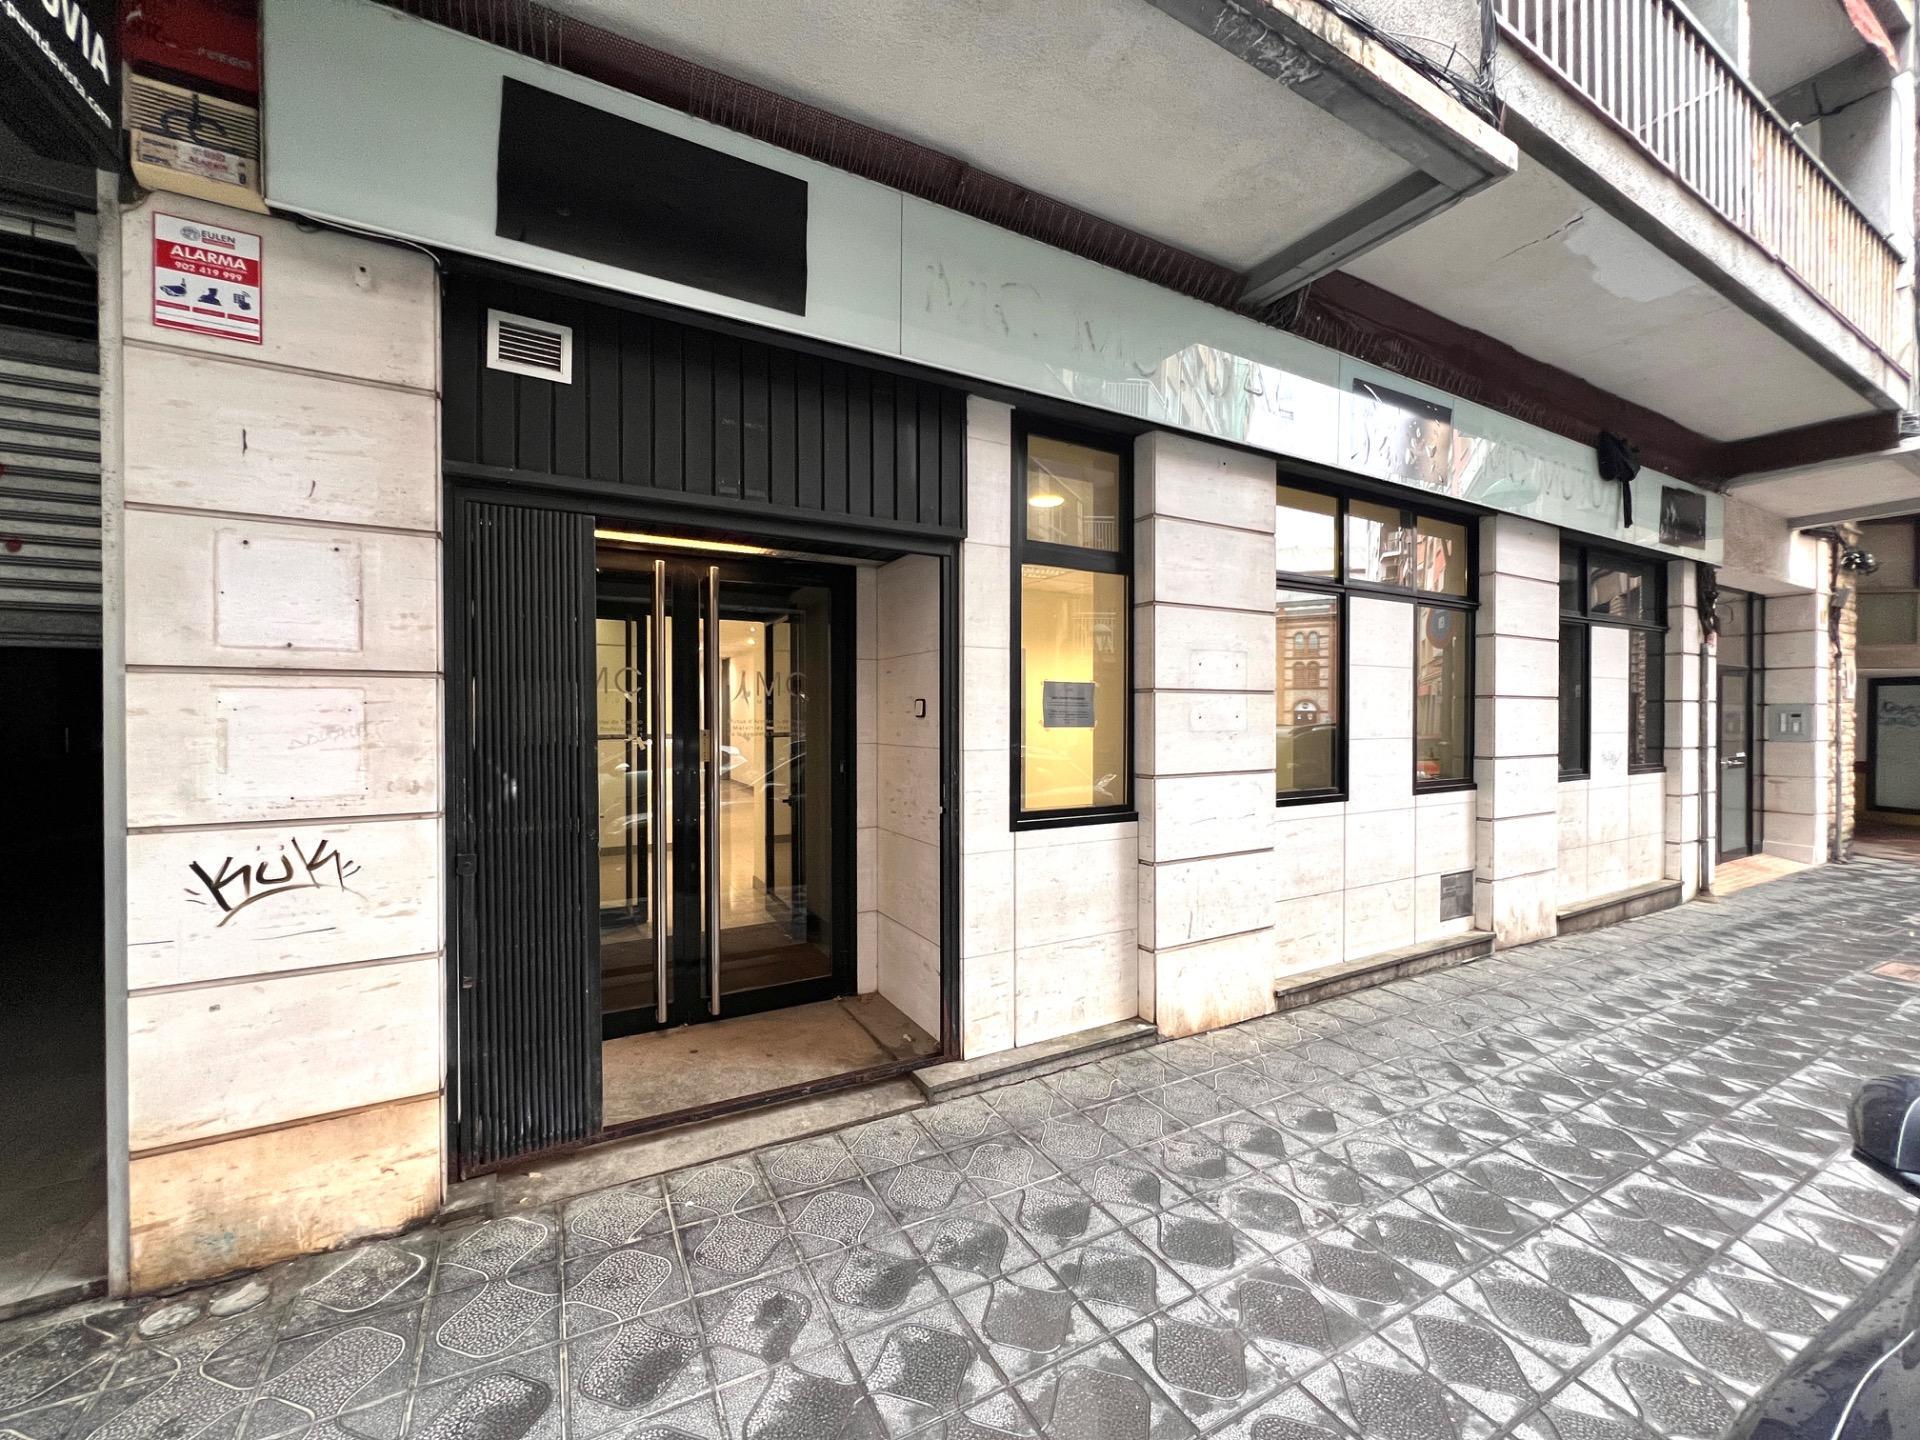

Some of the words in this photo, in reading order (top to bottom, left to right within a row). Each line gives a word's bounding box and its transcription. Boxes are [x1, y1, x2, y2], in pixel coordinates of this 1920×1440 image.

[201, 230, 235, 243] EULEN
[171, 245, 246, 270] ALARMA
[174, 261, 196, 272] 902
[199, 266, 219, 276] 419
[222, 271, 242, 281] 999
